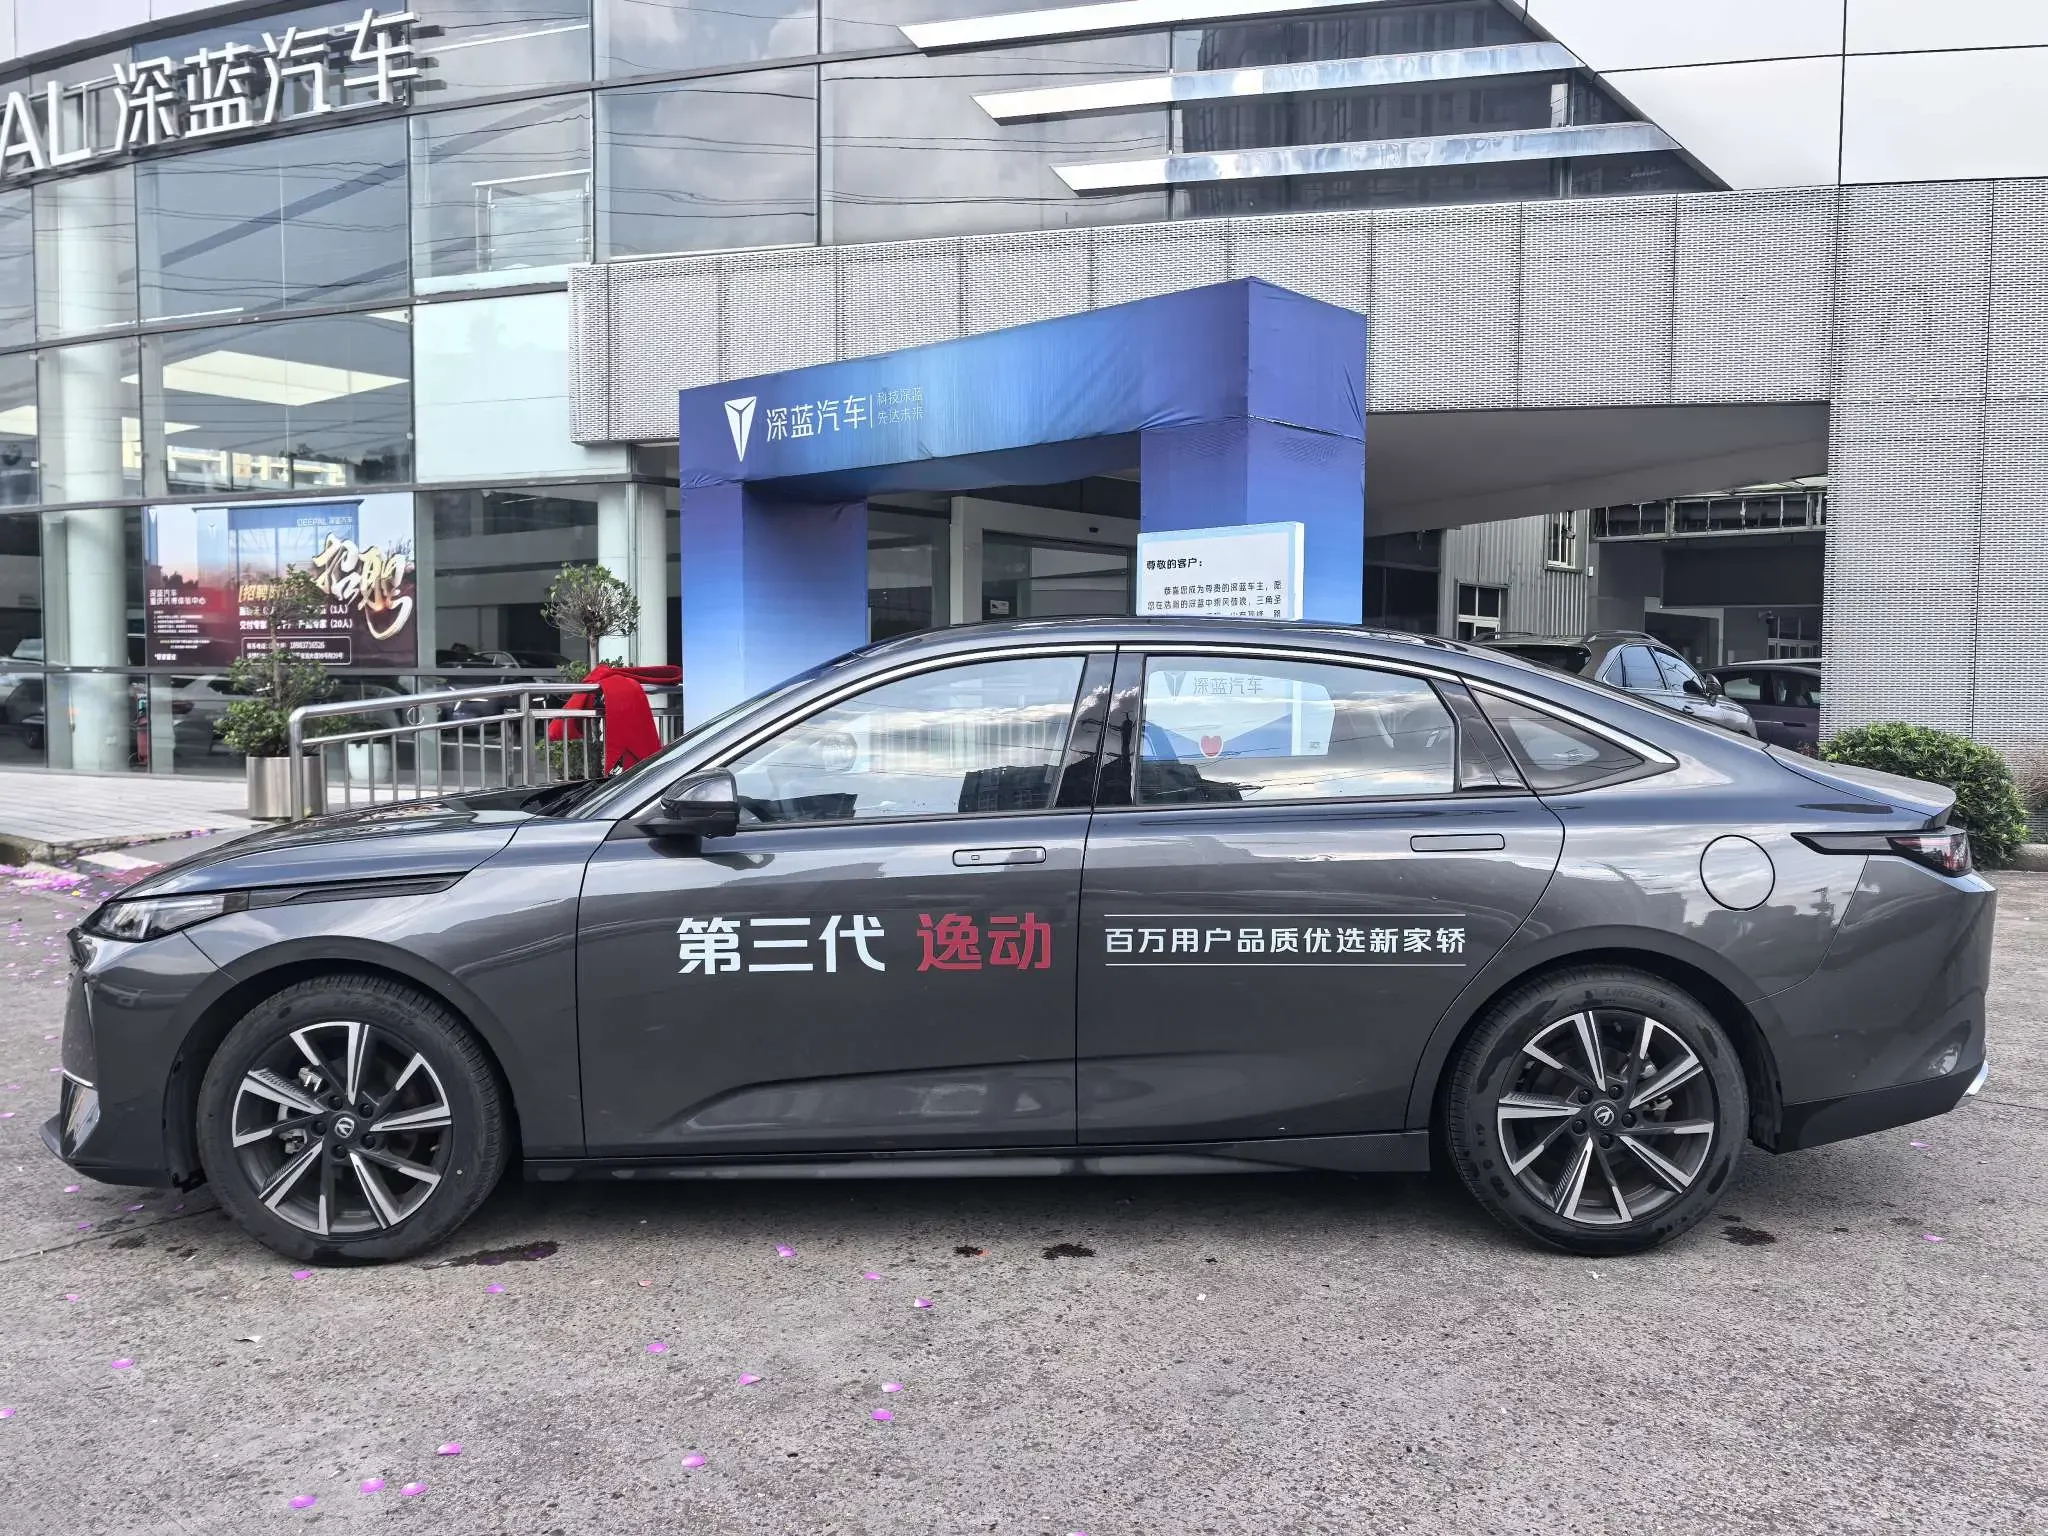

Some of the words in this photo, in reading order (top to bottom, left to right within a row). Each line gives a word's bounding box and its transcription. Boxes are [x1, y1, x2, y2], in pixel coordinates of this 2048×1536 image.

[113, 8, 423, 152] 深蓝汽车
[876, 386, 923, 406] 科技深蓝
[766, 395, 867, 442] 深蓝汽车
[1146, 557, 1203, 571] 尊敬的客户：
[1193, 677, 1264, 696] 深蓝汽车
[676, 914, 886, 975] 第三代
[916, 912, 1052, 972] 逸动
[1105, 927, 1466, 954] 百万用户品质优选新家轿
